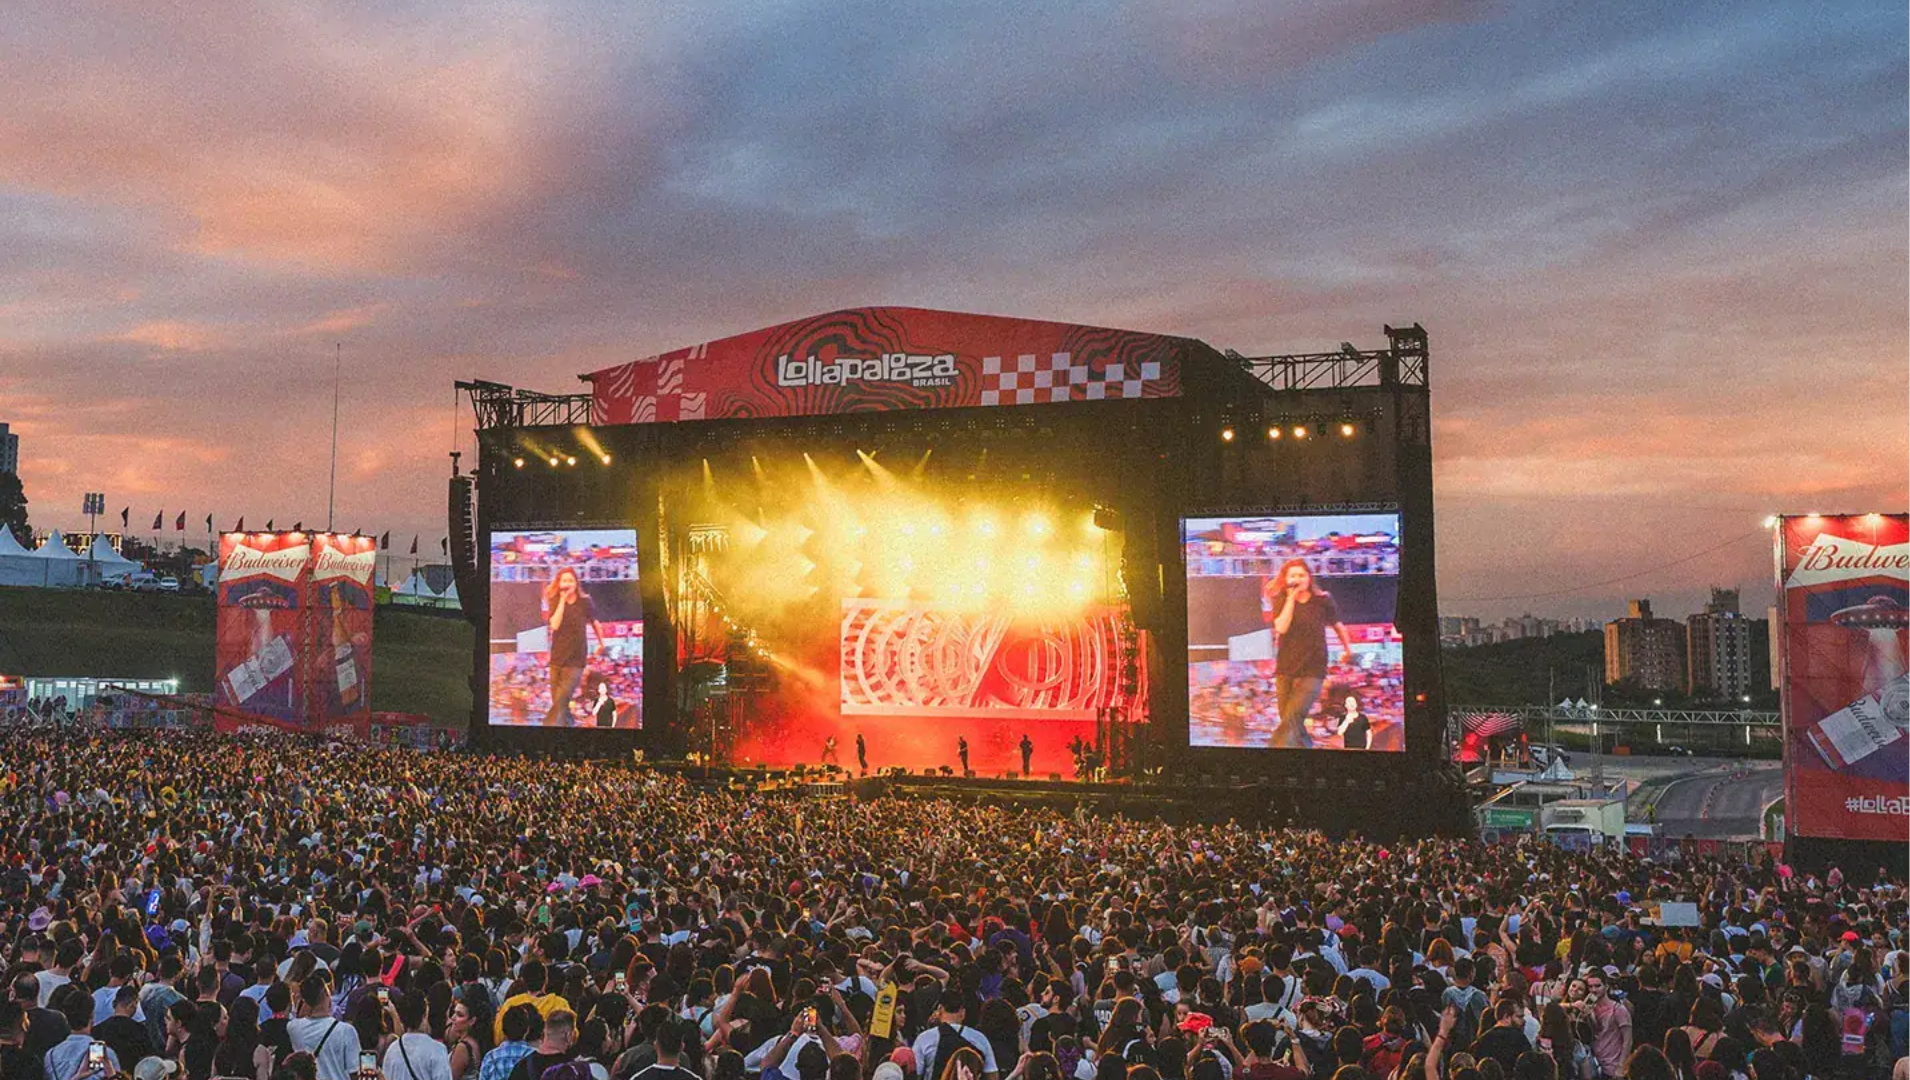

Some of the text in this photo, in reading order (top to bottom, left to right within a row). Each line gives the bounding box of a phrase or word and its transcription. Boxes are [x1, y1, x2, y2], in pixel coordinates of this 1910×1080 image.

[777, 353, 960, 387] Lollapalooza
[912, 379, 951, 387] BRASIL
[225, 551, 309, 570] Budweiser
[315, 552, 374, 570] Budweiser
[1797, 544, 1908, 571] Budwe
